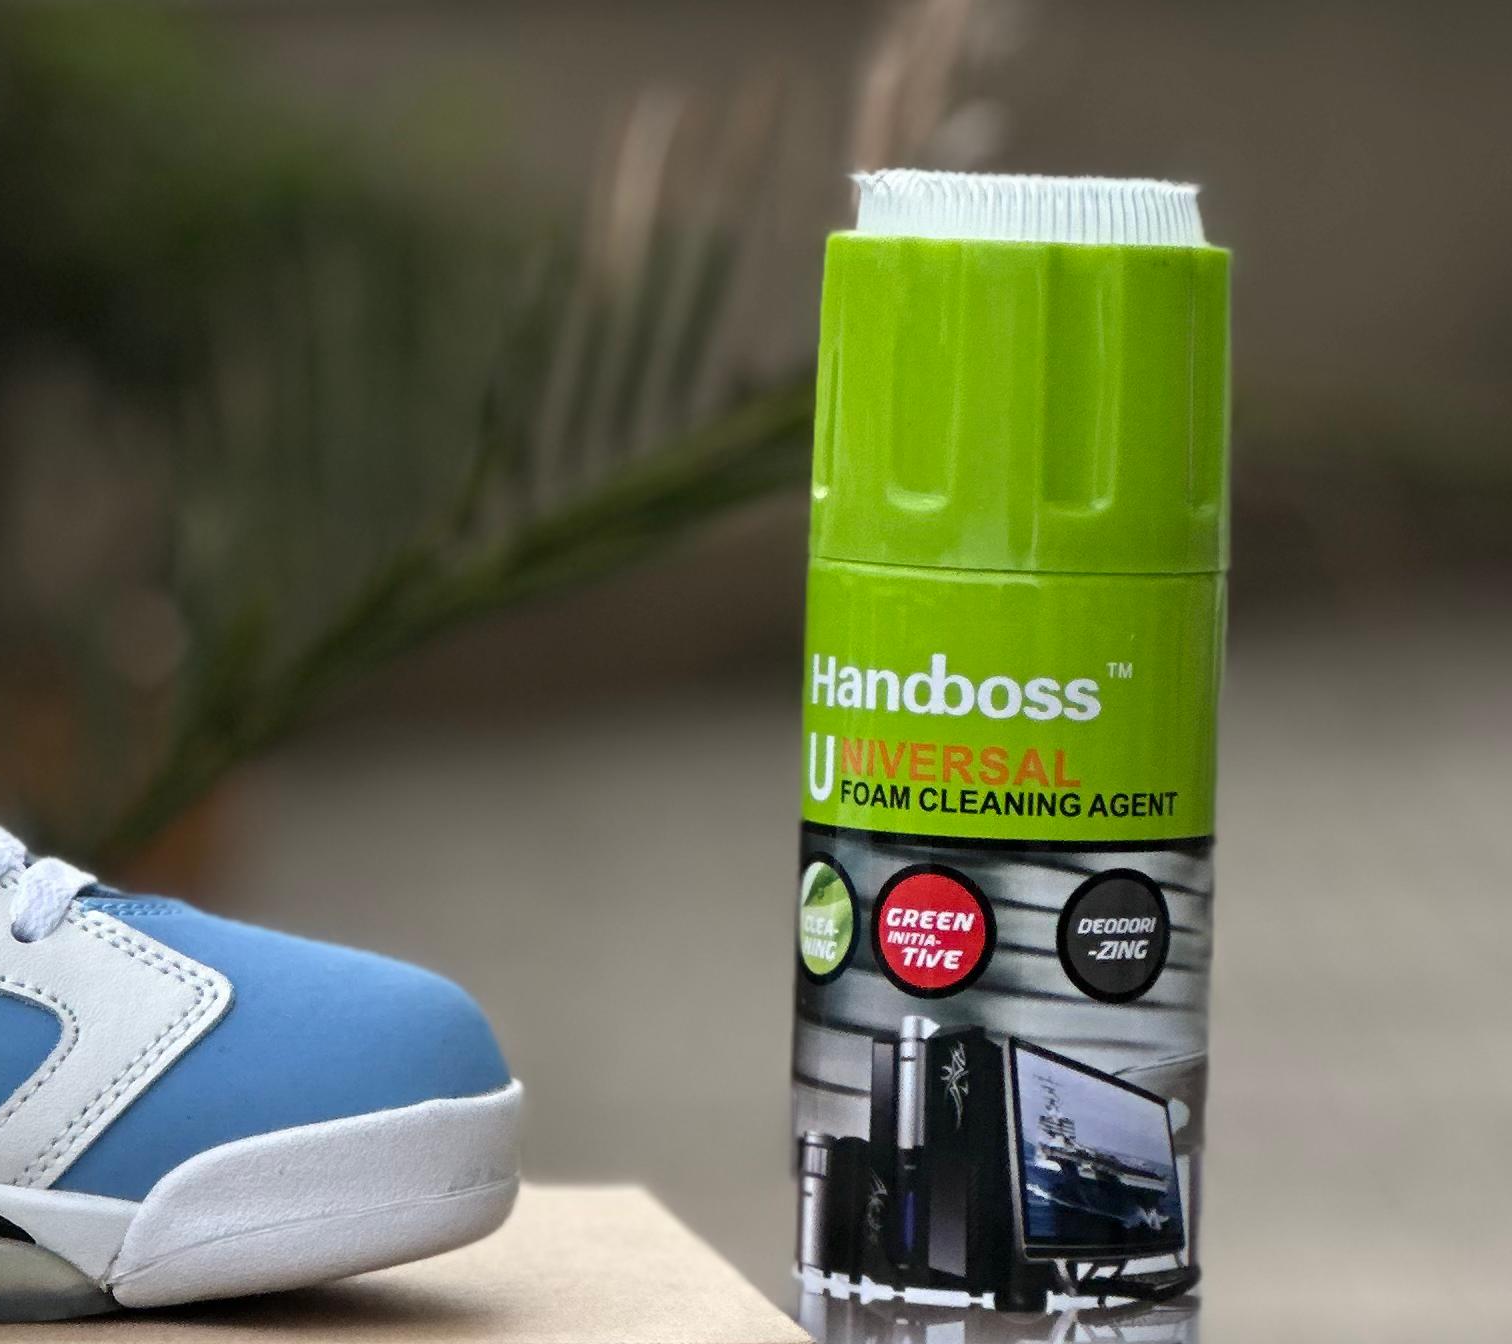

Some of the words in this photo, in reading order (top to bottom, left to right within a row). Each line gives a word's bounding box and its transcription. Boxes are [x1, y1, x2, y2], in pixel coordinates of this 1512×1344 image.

[811, 653, 1102, 722] Handboss
[840, 779, 910, 811] FOAM
[918, 787, 1082, 819] CLEANING
[1088, 790, 1178, 818] AGENT
[886, 907, 975, 933] GREEN
[1077, 917, 1157, 935] DEODORI
[887, 930, 942, 947] INITIA-
[1088, 939, 1149, 961] -ZING
